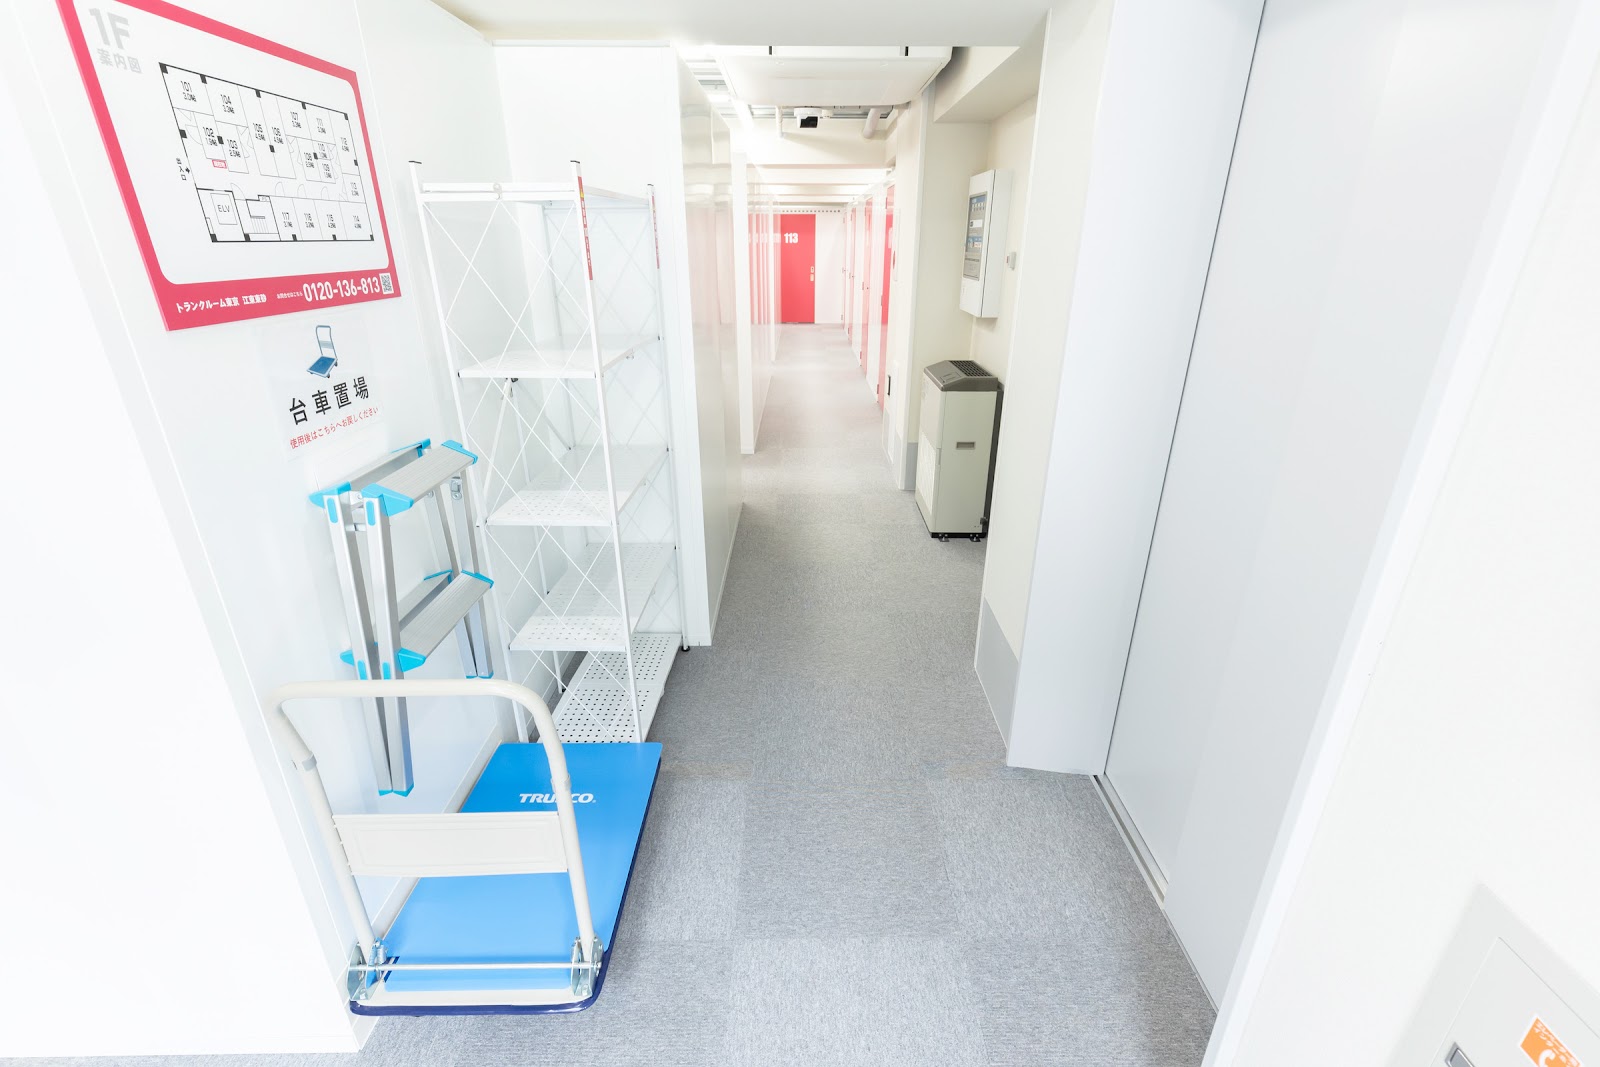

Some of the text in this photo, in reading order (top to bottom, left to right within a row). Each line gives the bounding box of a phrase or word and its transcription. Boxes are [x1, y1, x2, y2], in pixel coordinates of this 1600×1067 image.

[89, 8, 130, 50] 1F
[97, 48, 142, 74] 案内図
[180, 80, 193, 92] 101
[220, 94, 232, 104] 104
[290, 111, 299, 121] 107
[203, 126, 215, 138] 102
[252, 122, 264, 133] 105
[227, 138, 239, 150] 103
[217, 204, 230, 213] ELV
[783, 232, 799, 244] 113
[176, 296, 240, 314] トランクルーム東京
[302, 276, 381, 302] 0120-136-813
[289, 376, 370, 426] 台車置場
[289, 407, 379, 450] 使用後はこちらへお戻しください
[519, 793, 595, 804] TRUCO
